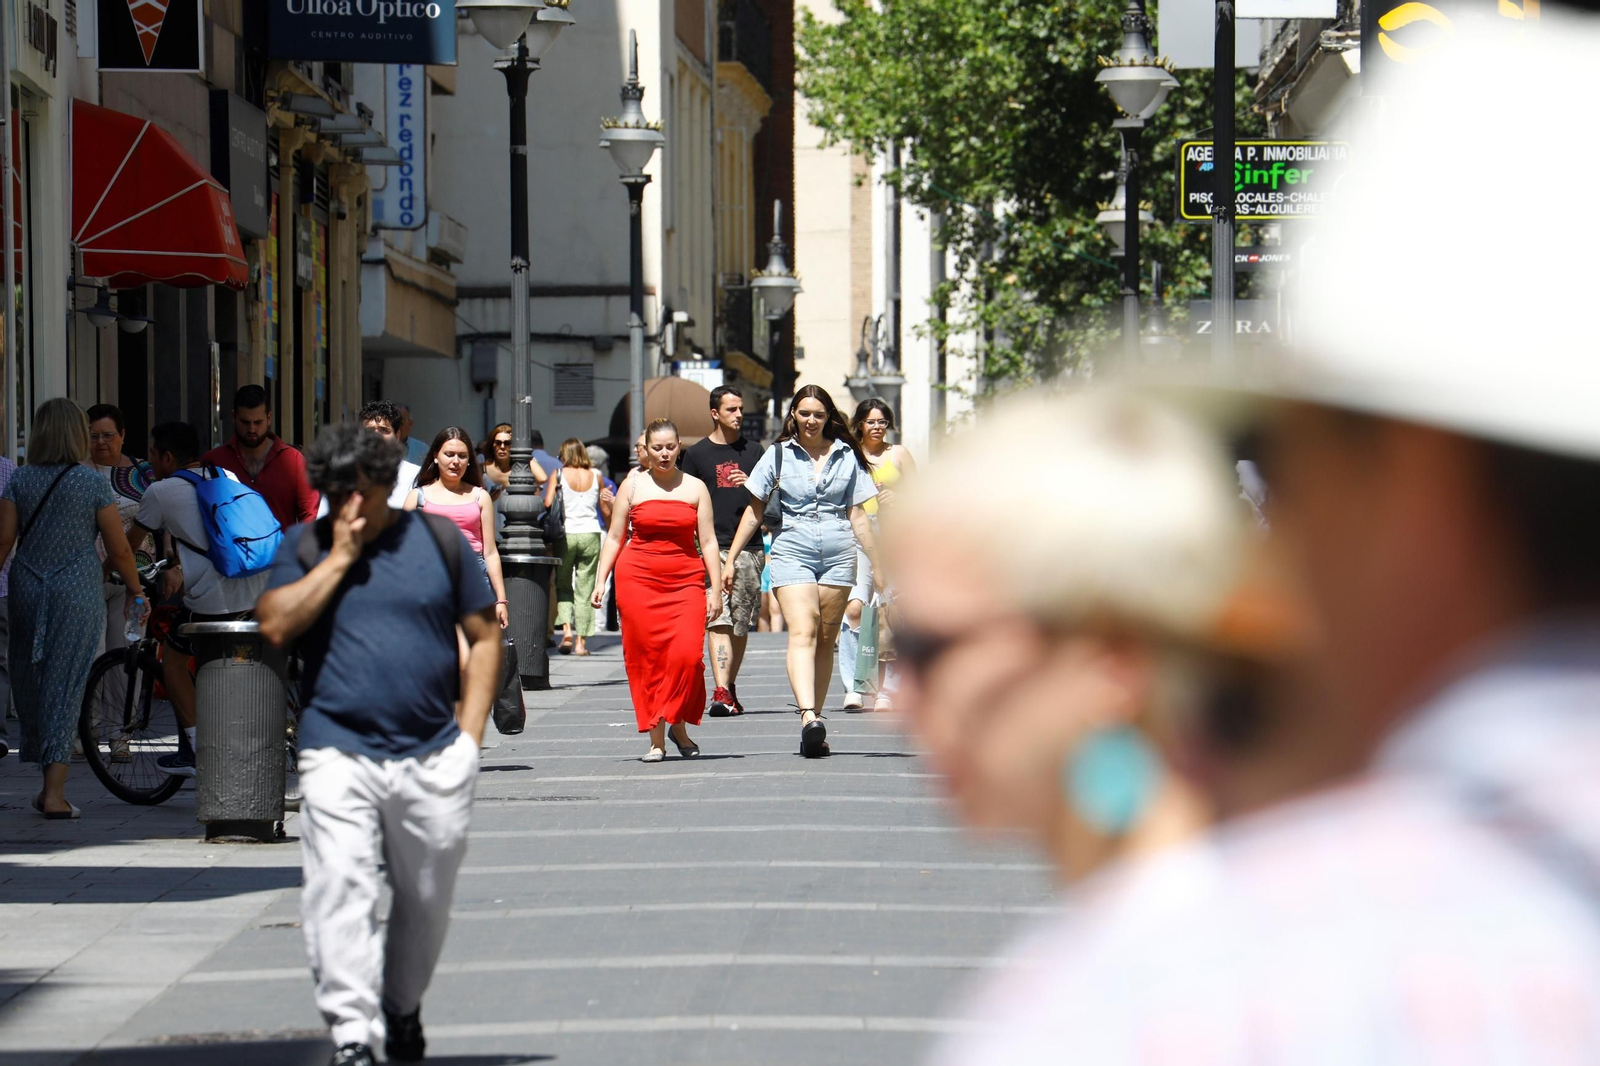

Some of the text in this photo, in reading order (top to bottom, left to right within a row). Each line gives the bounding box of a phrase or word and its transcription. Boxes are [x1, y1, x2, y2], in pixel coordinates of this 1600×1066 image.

[311, 30, 413, 41] CENTRO AUDITIVO
[1247, 147, 1259, 161] P.
[1263, 146, 1348, 161] INMOBILIAIA
[398, 113, 414, 227] redondo
[1196, 320, 1272, 334] ZRA
